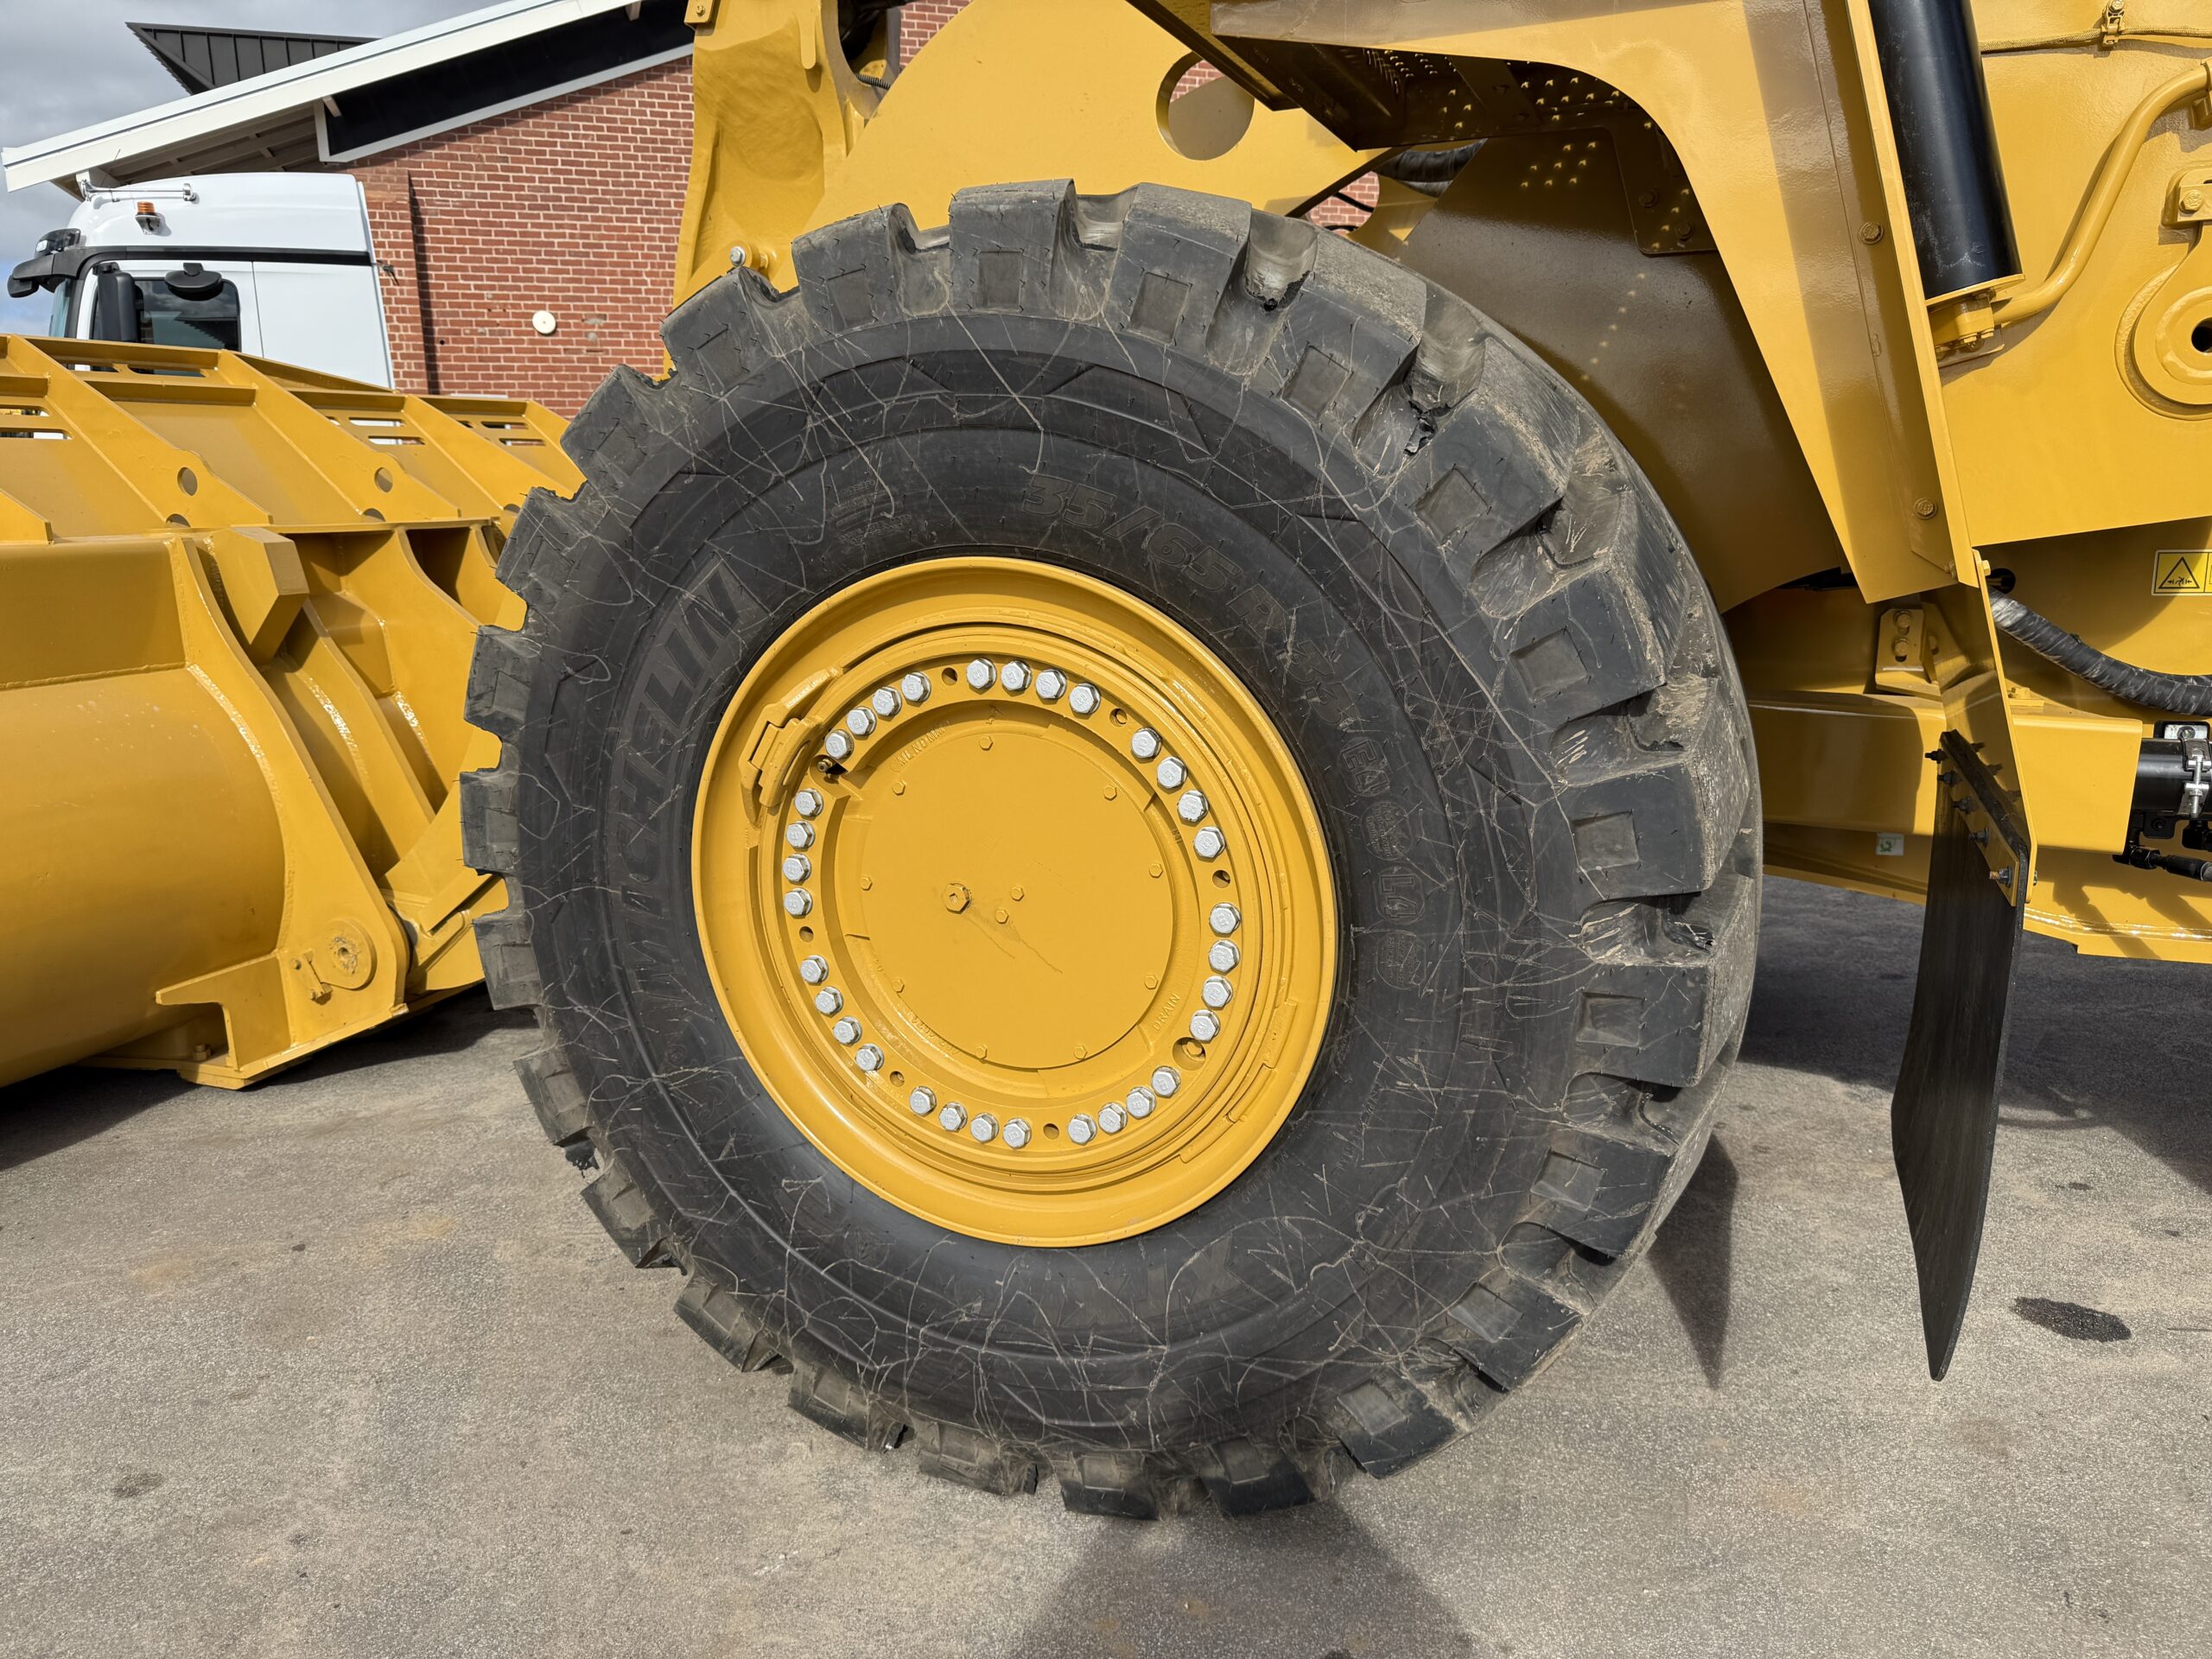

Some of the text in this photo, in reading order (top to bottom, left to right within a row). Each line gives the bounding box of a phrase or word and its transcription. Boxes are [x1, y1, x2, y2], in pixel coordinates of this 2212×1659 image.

[1021, 474, 1242, 593] 35/65
[614, 572, 750, 1010] MICHELIN
[1150, 991, 1180, 1033] DRAIN
